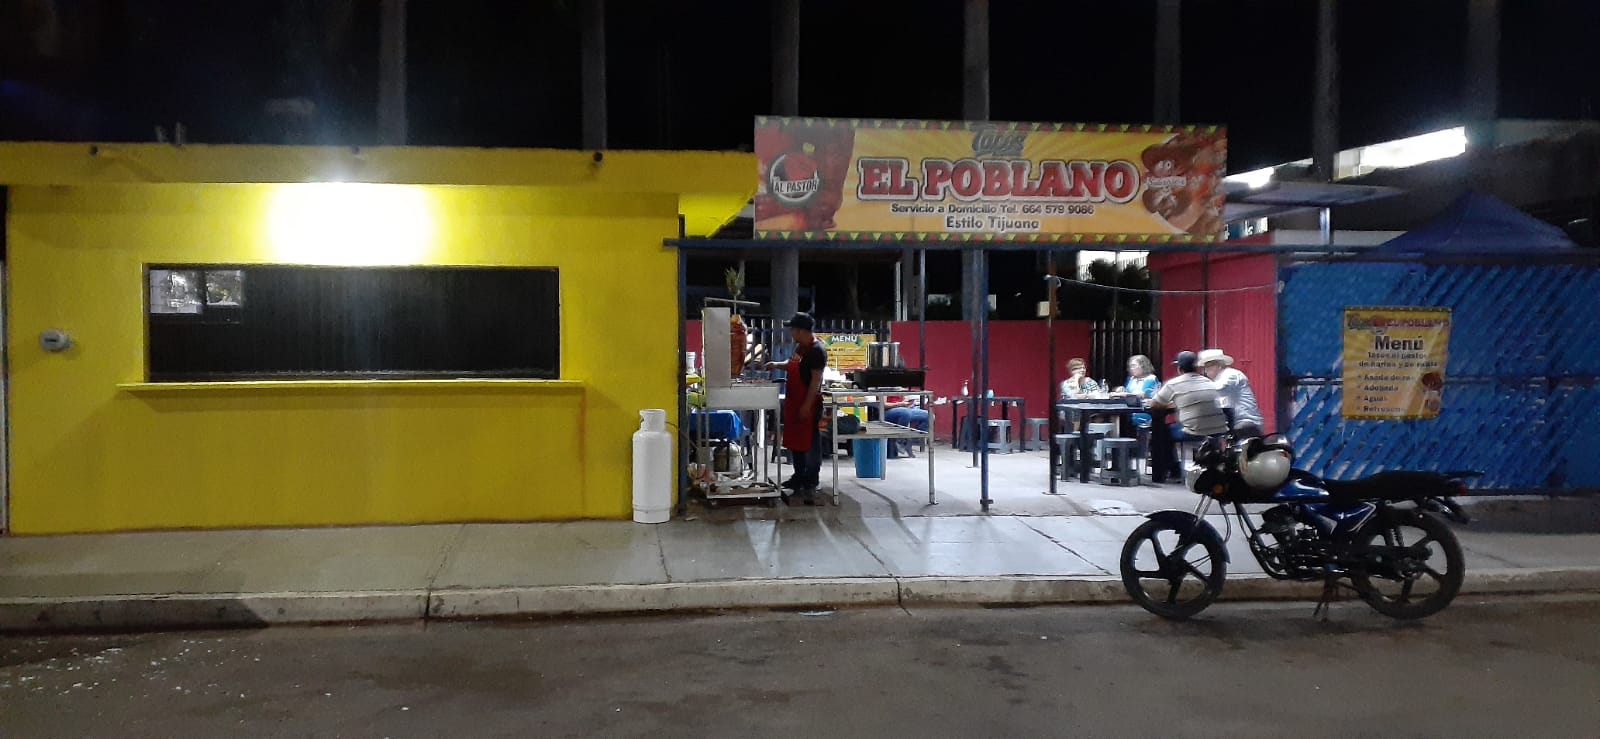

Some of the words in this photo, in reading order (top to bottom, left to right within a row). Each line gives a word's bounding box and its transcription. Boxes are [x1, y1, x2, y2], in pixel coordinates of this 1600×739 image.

[774, 181, 785, 193] AL
[786, 178, 818, 192] PASTOR
[857, 158, 919, 201] EL
[922, 159, 1138, 202] POBLANO
[891, 203, 935, 214] Servicio
[948, 204, 997, 214] Domicilio
[1022, 204, 1042, 214] 664
[946, 216, 983, 229] Estilo
[988, 216, 1039, 231] Tijuana
[1375, 335, 1424, 351] Menú
